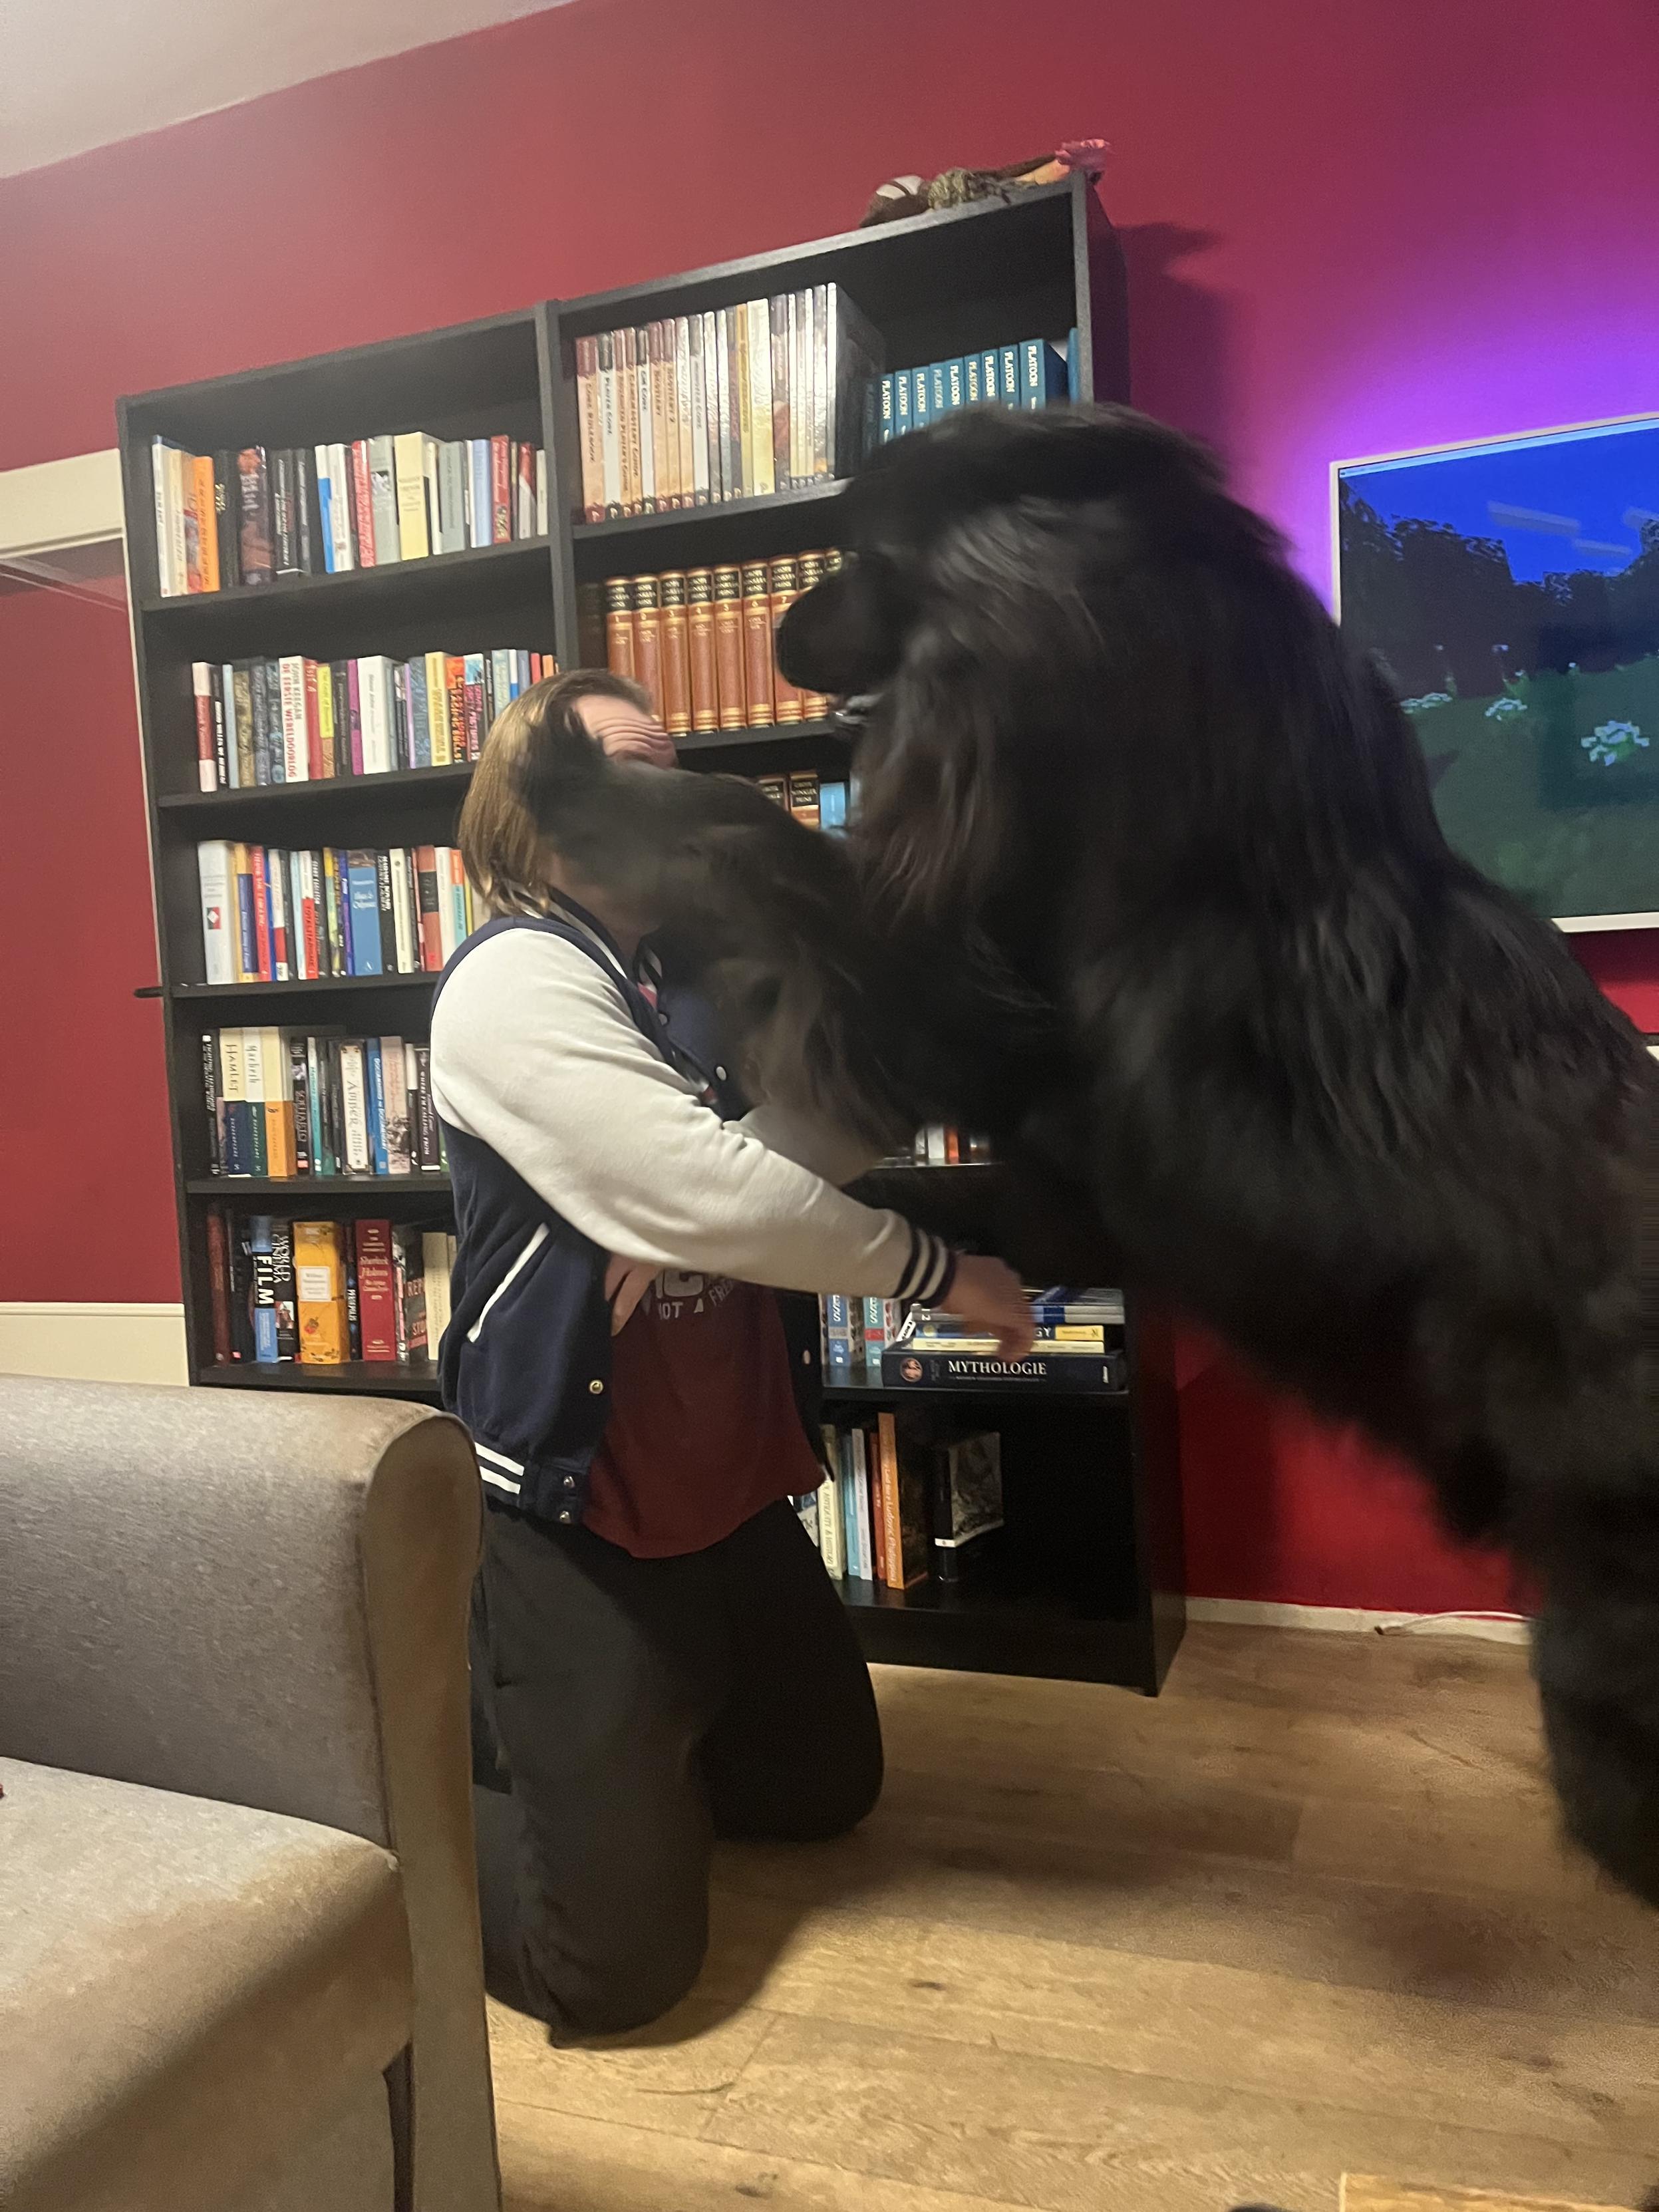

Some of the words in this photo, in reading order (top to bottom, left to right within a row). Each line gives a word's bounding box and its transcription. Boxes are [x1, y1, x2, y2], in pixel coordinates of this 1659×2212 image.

[950, 365, 961, 406] PLATOON
[969, 361, 978, 401] PLATOON
[984, 356, 995, 397] PLATOON
[1004, 351, 1015, 393] PLATOON
[1028, 345, 1038, 387] PLATOON
[899, 377, 908, 415] PLATOON
[917, 373, 926, 412] PLATOON
[282, 664, 291, 673] DE
[283, 677, 293, 706] EERSTE
[293, 687, 303, 720] KEEGAN
[285, 709, 297, 778] WERELDOORLOG
[225, 1044, 239, 1094] HAMLET
[245, 1045, 261, 1084] Macbeth
[279, 1235, 291, 1281] WORLD
[257, 1256, 274, 1304] FILM
[694, 1298, 704, 1313] A
[948, 1360, 1047, 1375] MYTHOLOGIE
